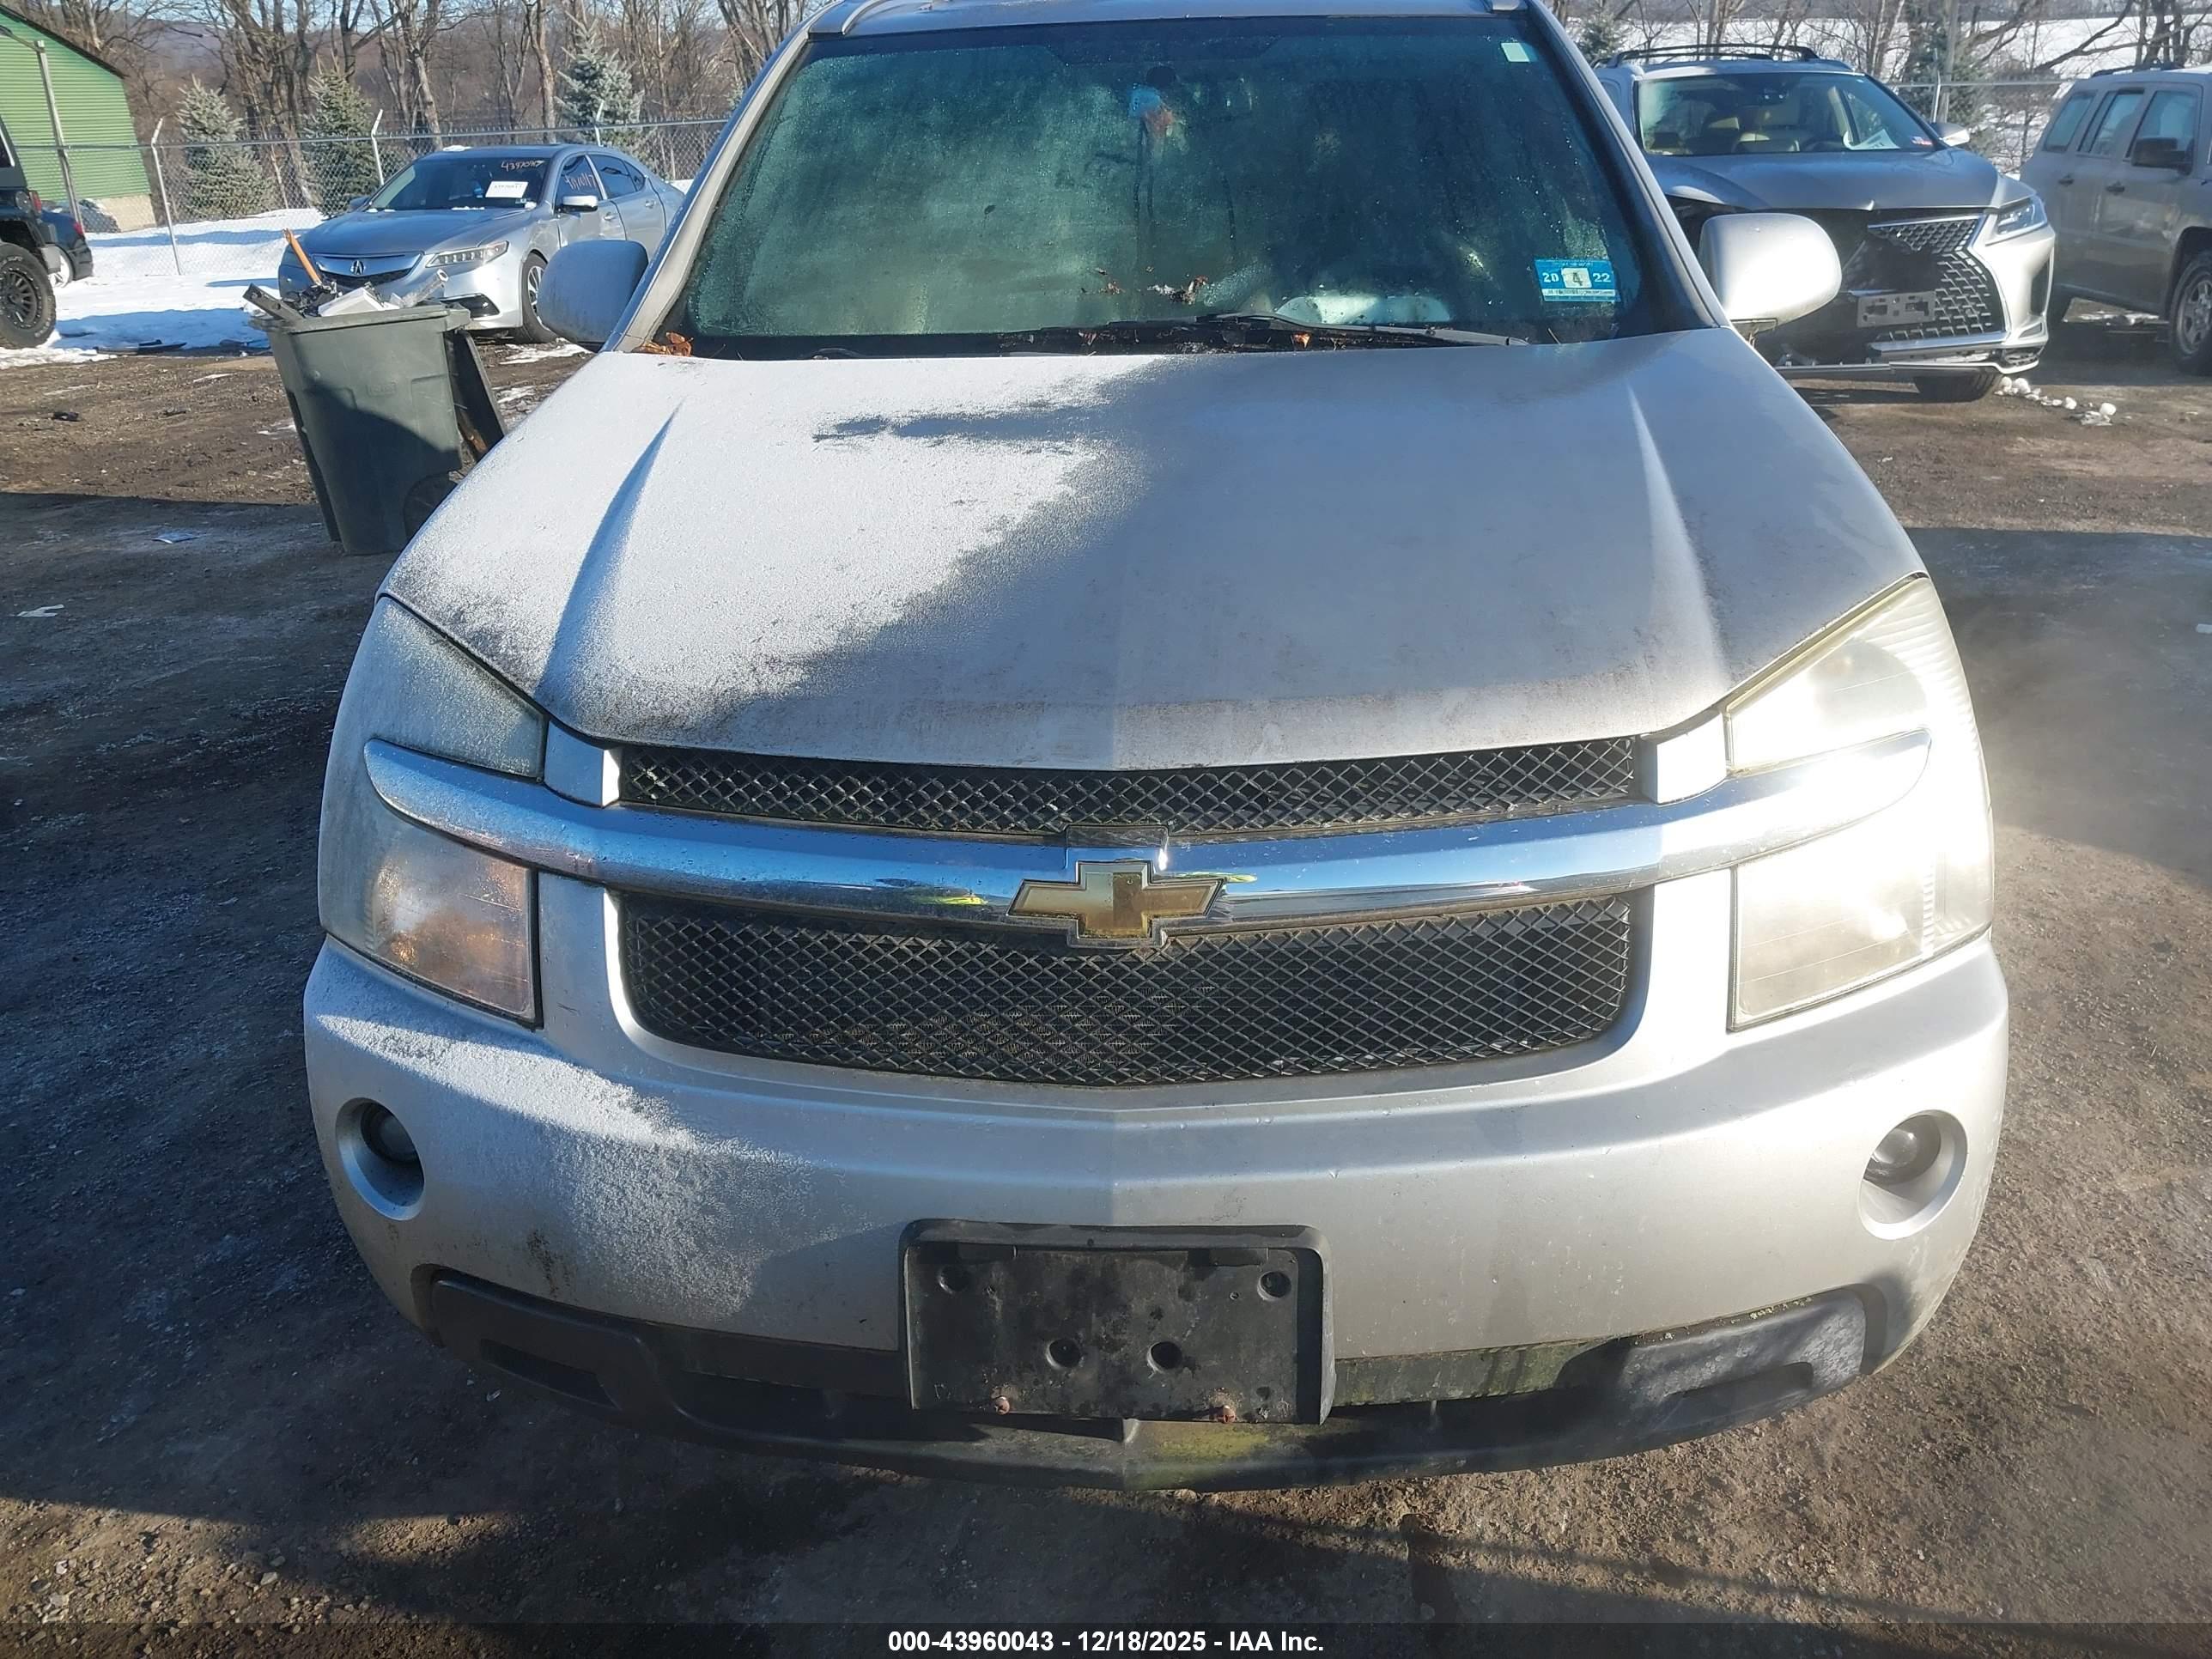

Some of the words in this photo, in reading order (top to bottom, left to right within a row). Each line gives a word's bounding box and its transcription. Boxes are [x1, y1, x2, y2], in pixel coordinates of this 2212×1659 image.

[1542, 272, 1559, 283] 20
[1572, 272, 1583, 286] 4
[1592, 272, 1612, 283] 22
